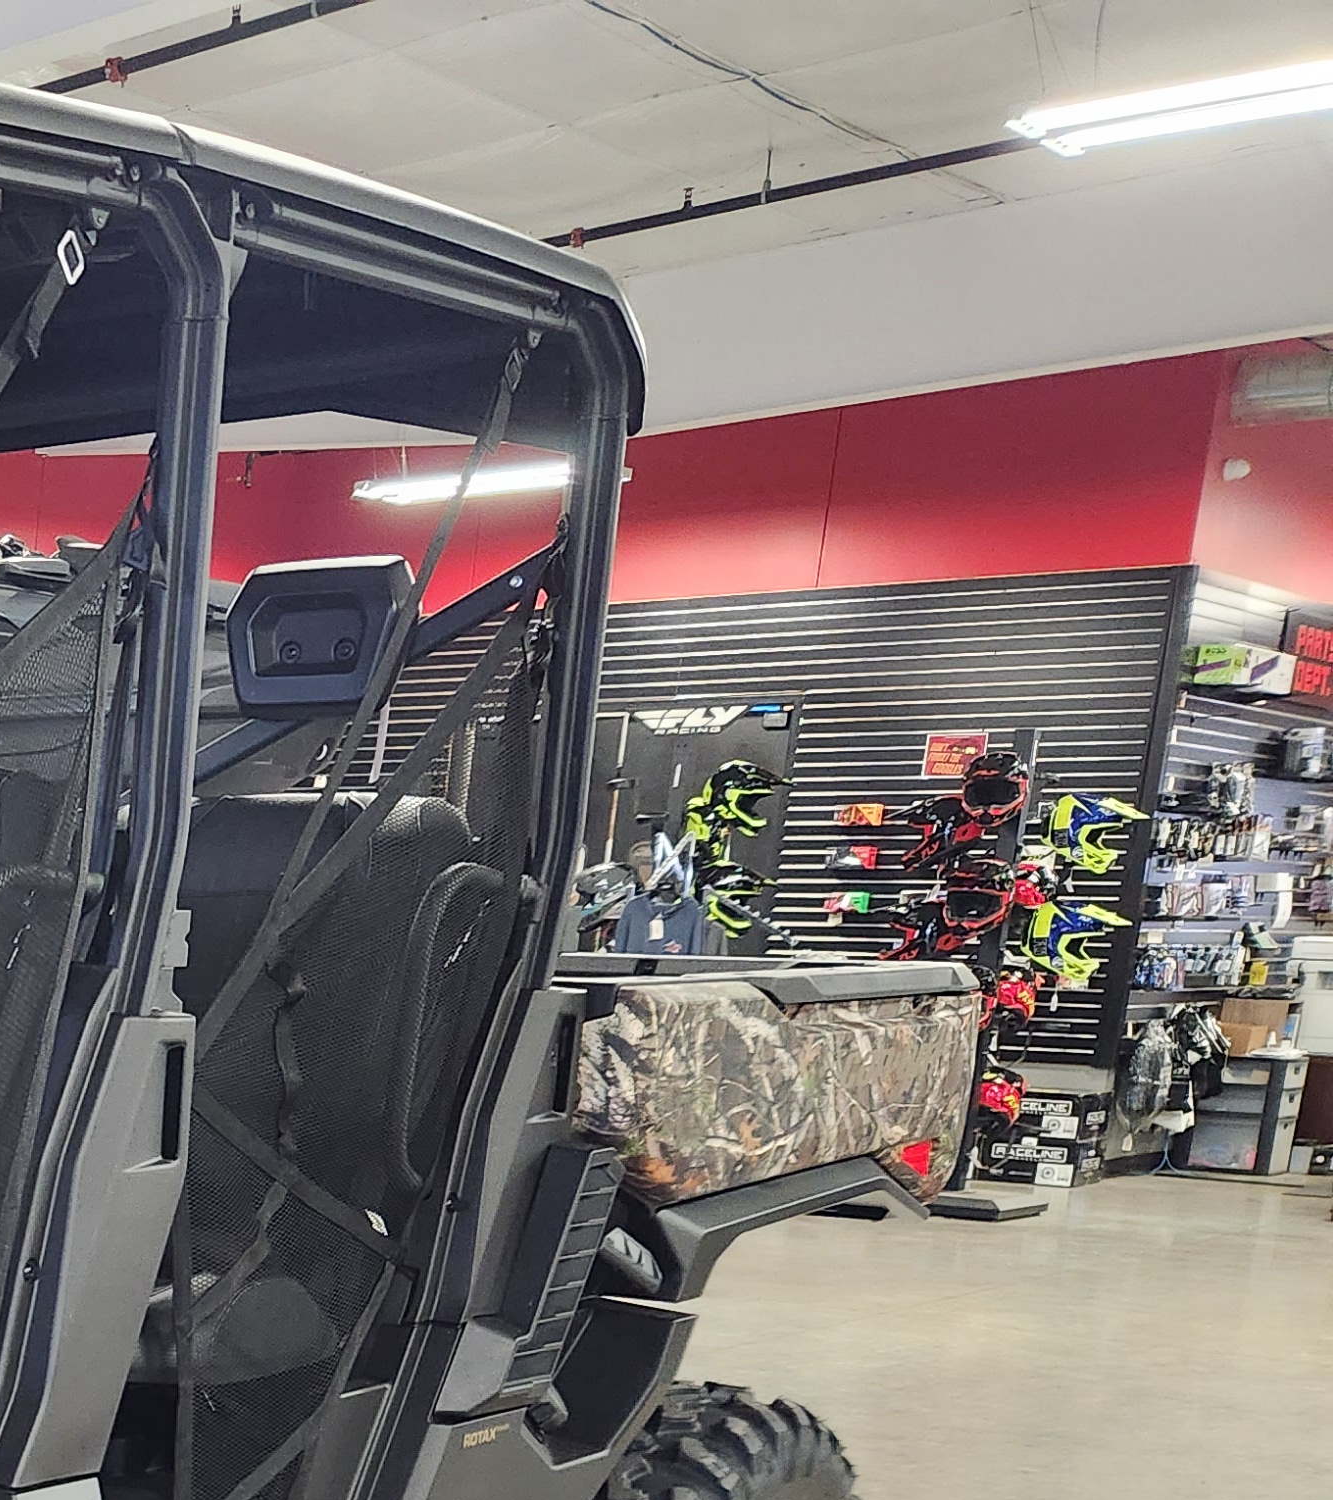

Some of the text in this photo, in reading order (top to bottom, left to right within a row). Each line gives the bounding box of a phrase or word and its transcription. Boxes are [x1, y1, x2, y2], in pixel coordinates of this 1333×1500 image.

[1294, 660, 1332, 697] DEPT.
[633, 704, 749, 730] FLY
[653, 726, 723, 736] RACING
[1020, 1101, 1069, 1113] CELINE
[995, 1146, 1064, 1160] RACELINE
[462, 1426, 497, 1449] ROTAX
